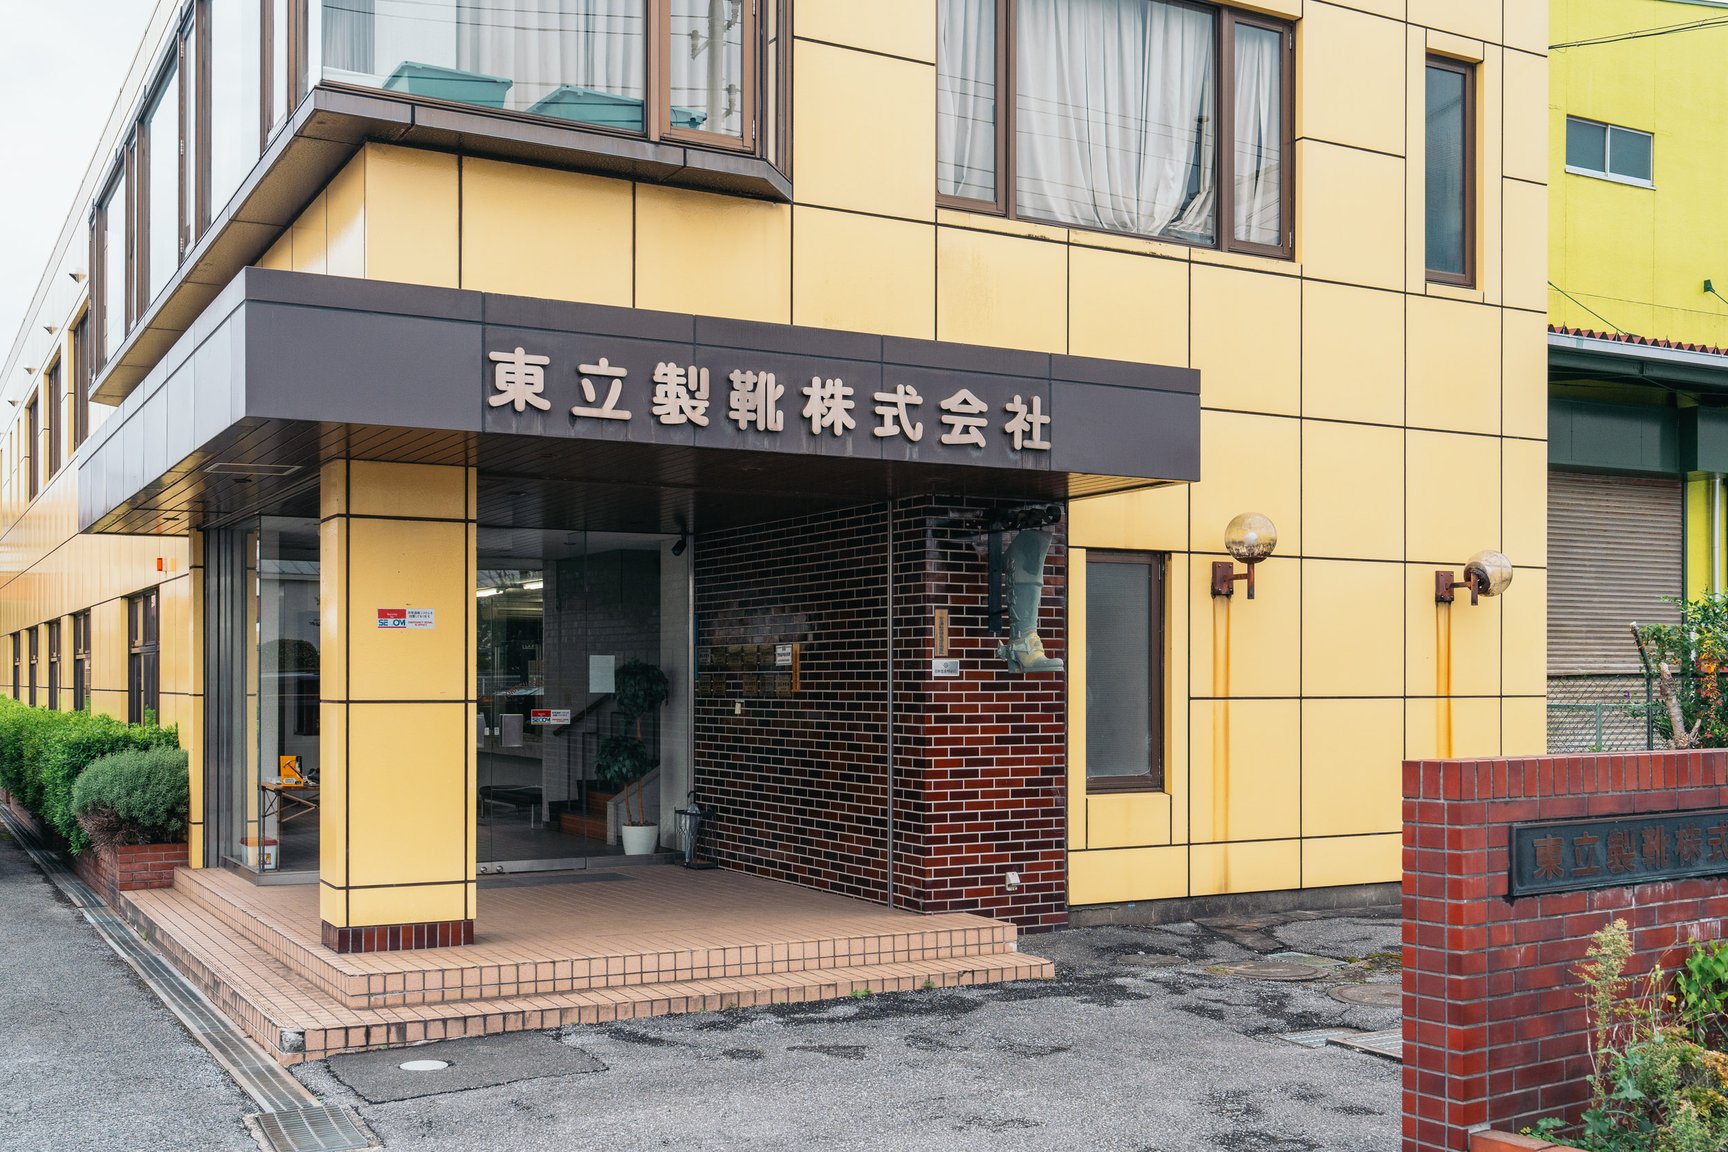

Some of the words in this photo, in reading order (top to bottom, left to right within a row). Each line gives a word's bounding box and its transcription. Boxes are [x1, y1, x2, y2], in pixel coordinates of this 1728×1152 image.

[488, 347, 1051, 451] 東立製靴株式会社
[1533, 821, 1728, 880] 東立製靴株式
